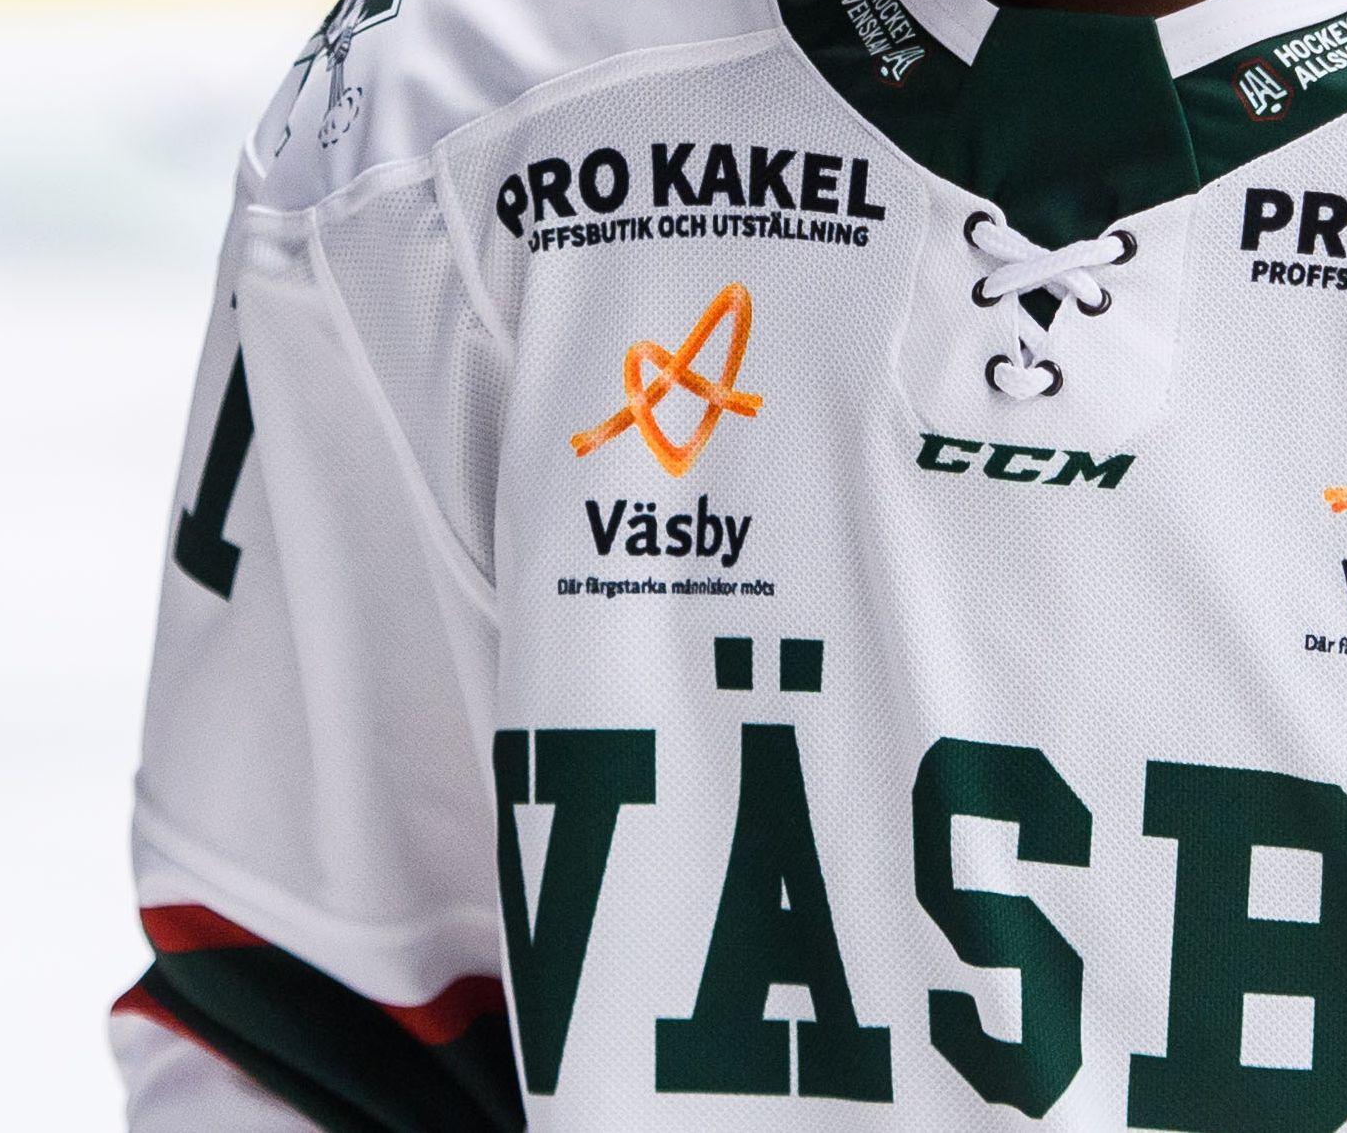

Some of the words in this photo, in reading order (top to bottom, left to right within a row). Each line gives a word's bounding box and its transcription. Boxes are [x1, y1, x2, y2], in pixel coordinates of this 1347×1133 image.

[496, 147, 629, 239] PRO
[652, 143, 886, 221] KAKEL
[657, 214, 706, 240] OCH
[713, 211, 870, 247] UTSTÄLLNING
[915, 432, 1137, 490] CCM
[585, 493, 753, 568] Väsby
[1304, 634, 1335, 653] Där
